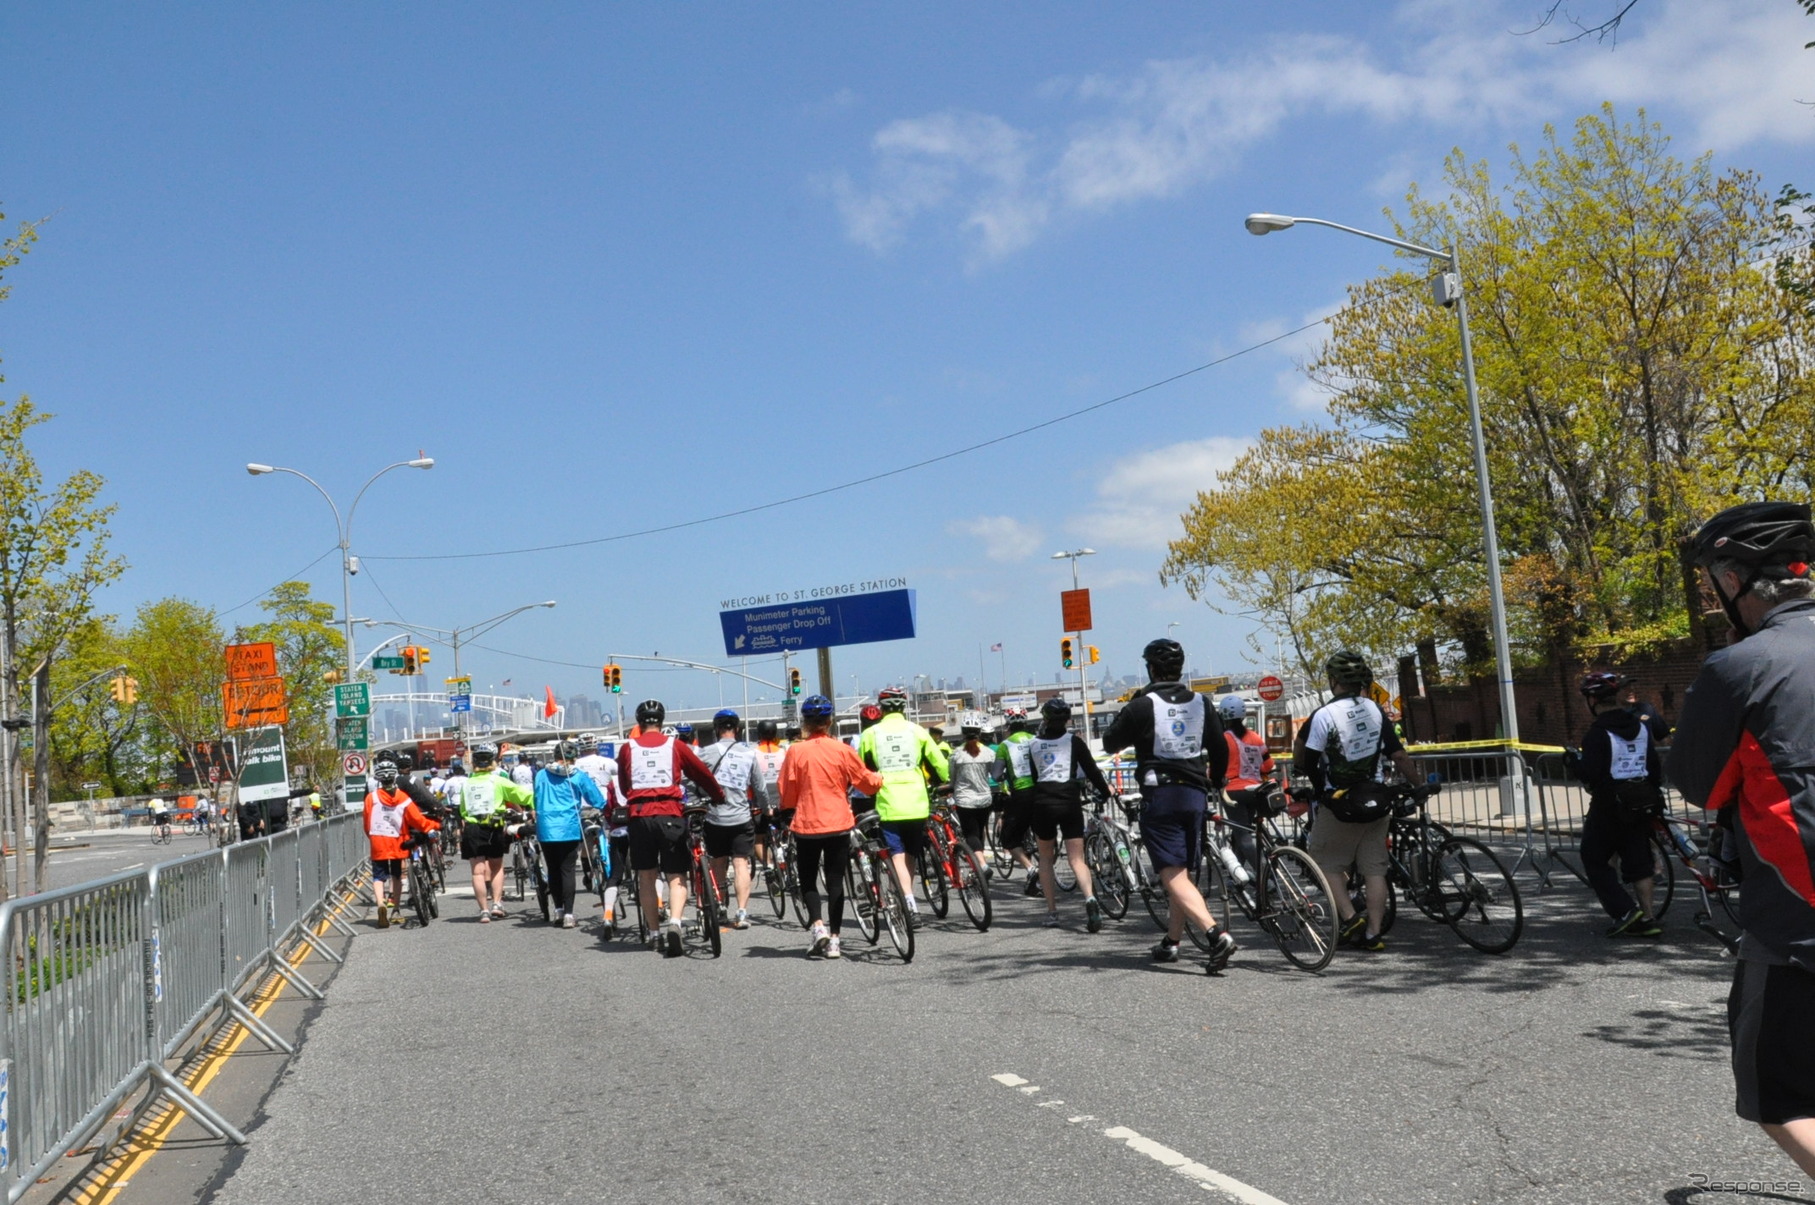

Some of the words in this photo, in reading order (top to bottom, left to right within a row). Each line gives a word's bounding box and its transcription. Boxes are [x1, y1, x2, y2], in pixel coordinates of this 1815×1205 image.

[720, 594, 771, 609] WELCOME
[775, 592, 789, 602] TO
[793, 590, 808, 600] ST.
[810, 583, 856, 598] GEORGE
[860, 576, 907, 592] STATION
[745, 610, 790, 622] Munimeter
[791, 606, 826, 616] Parking
[746, 621, 792, 634] Passenger
[793, 619, 815, 629] Drop
[817, 616, 831, 626] Off
[780, 636, 803, 645] Ferry
[262, 753, 282, 764] bike
